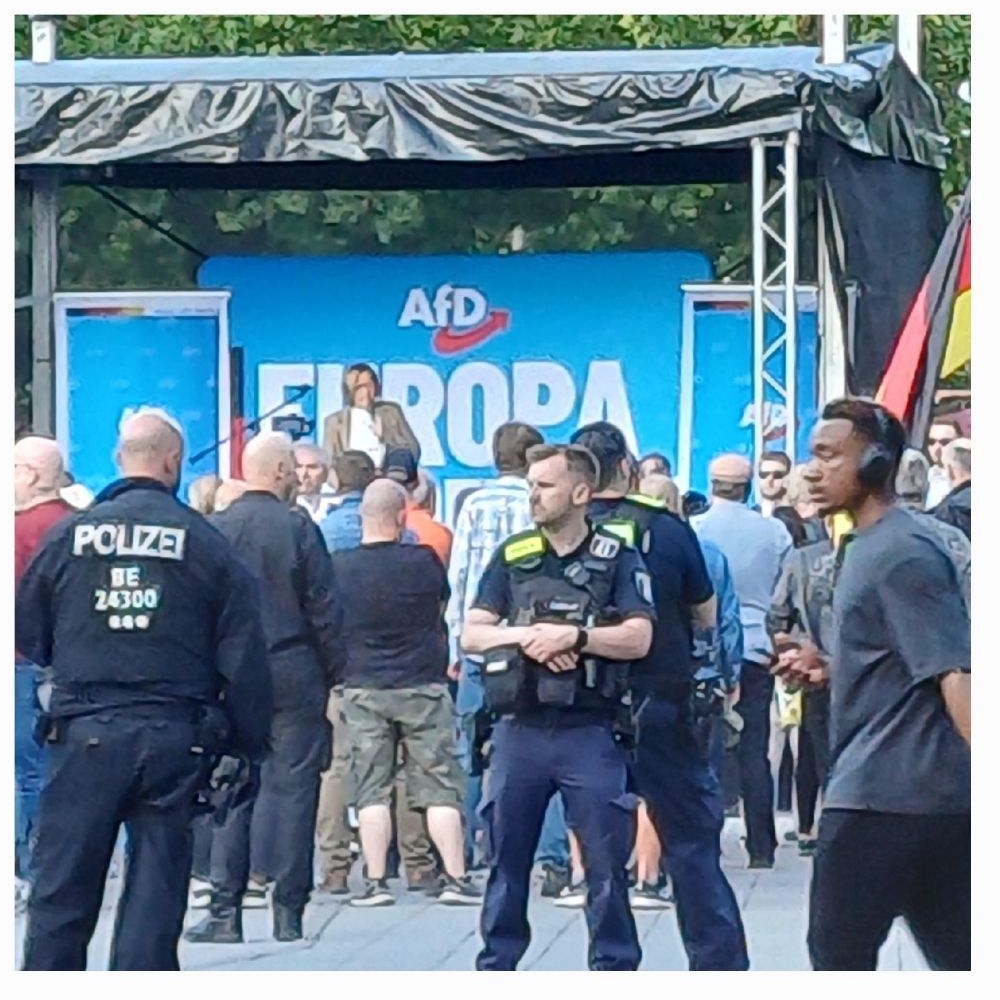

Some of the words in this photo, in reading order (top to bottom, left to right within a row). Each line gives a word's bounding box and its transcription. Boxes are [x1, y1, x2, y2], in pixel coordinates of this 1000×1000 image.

[398, 284, 488, 329] AfD
[72, 523, 186, 561] POLIZEI
[110, 567, 141, 588] BE
[94, 588, 158, 611] 24300
